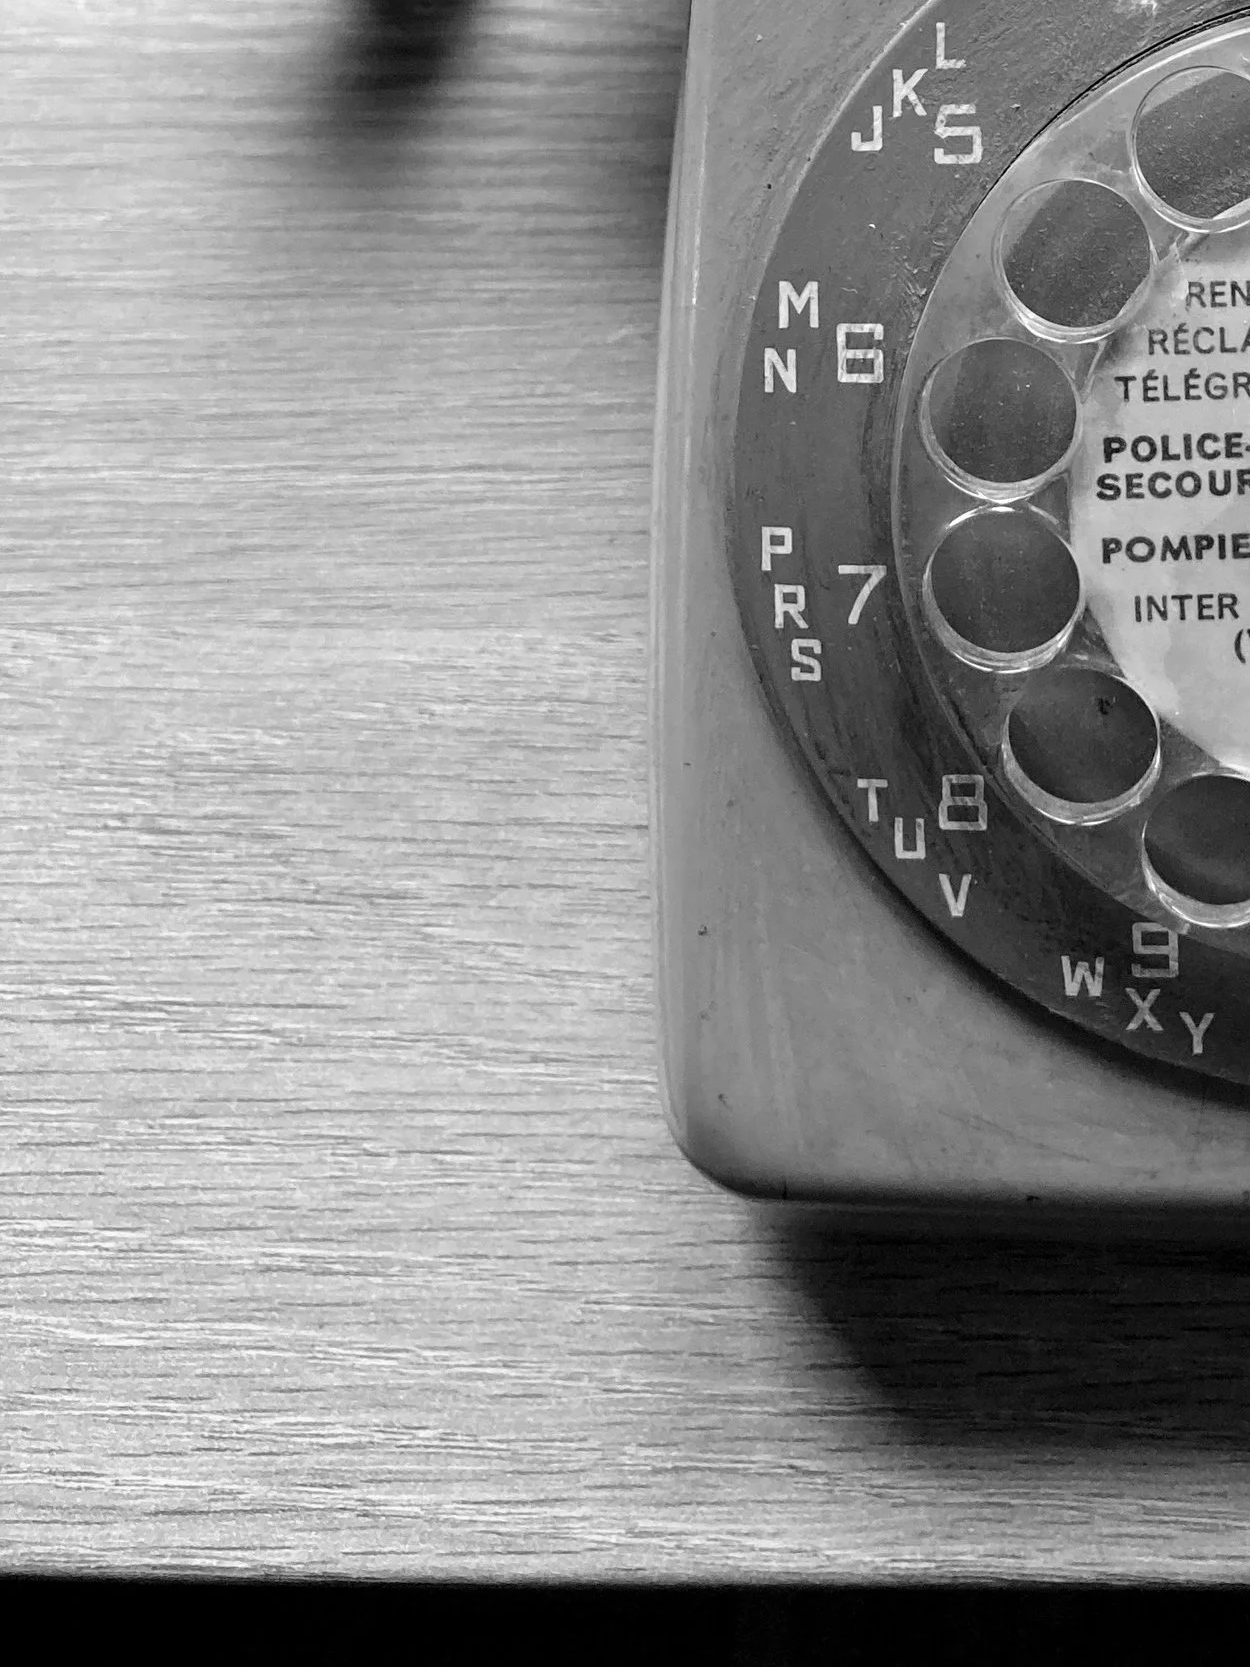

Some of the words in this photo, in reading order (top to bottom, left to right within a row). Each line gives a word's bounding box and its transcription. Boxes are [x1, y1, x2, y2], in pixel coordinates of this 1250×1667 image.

[933, 102, 983, 165] 5
[836, 322, 885, 384] 6
[837, 564, 888, 626] 7
[1134, 592, 1239, 623] INTER
[938, 774, 989, 832] 8
[1131, 921, 1180, 979] 9
